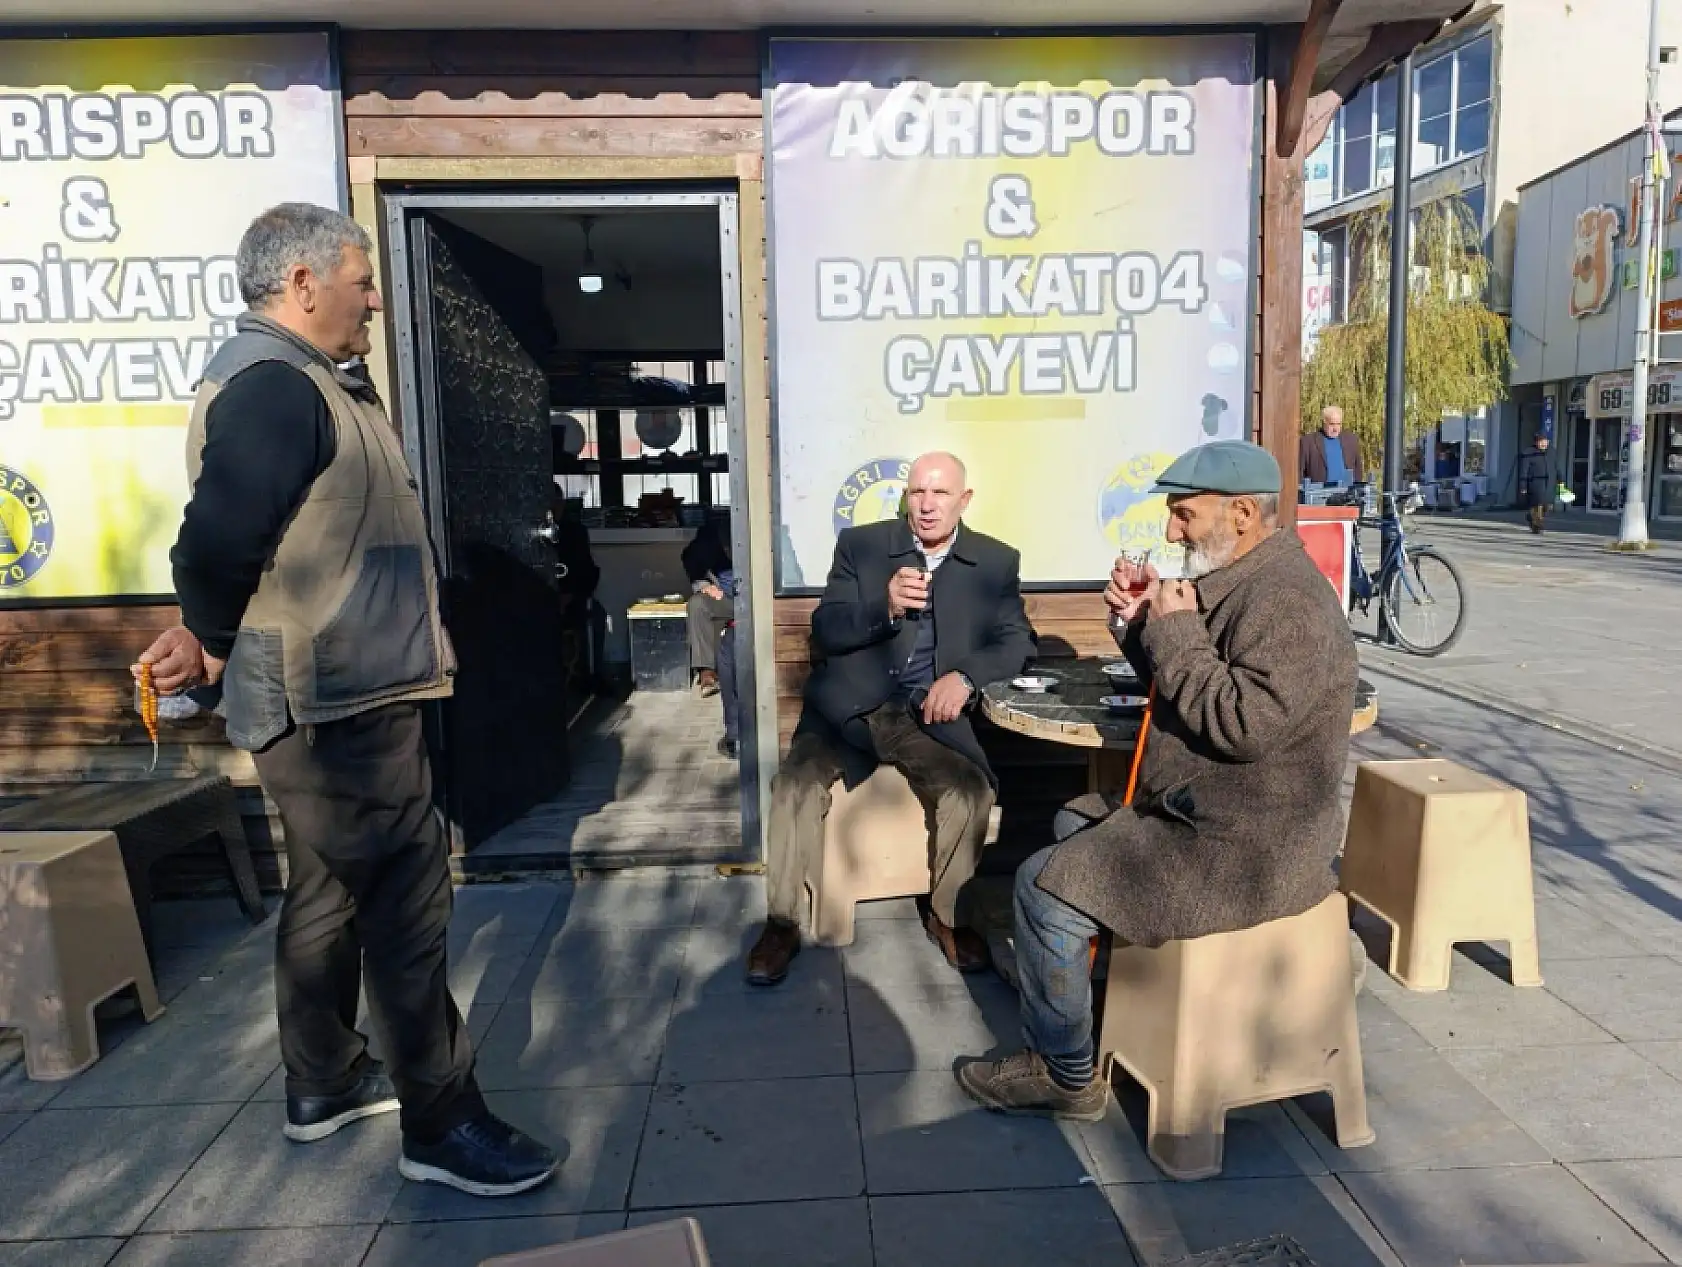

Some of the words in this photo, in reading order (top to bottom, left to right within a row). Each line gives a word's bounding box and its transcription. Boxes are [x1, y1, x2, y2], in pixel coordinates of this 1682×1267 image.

[60, 176, 121, 245] &
[985, 174, 1040, 239] &
[817, 240, 1209, 320] BARİKAT04
[885, 314, 1138, 412] ÇAYEVİ
